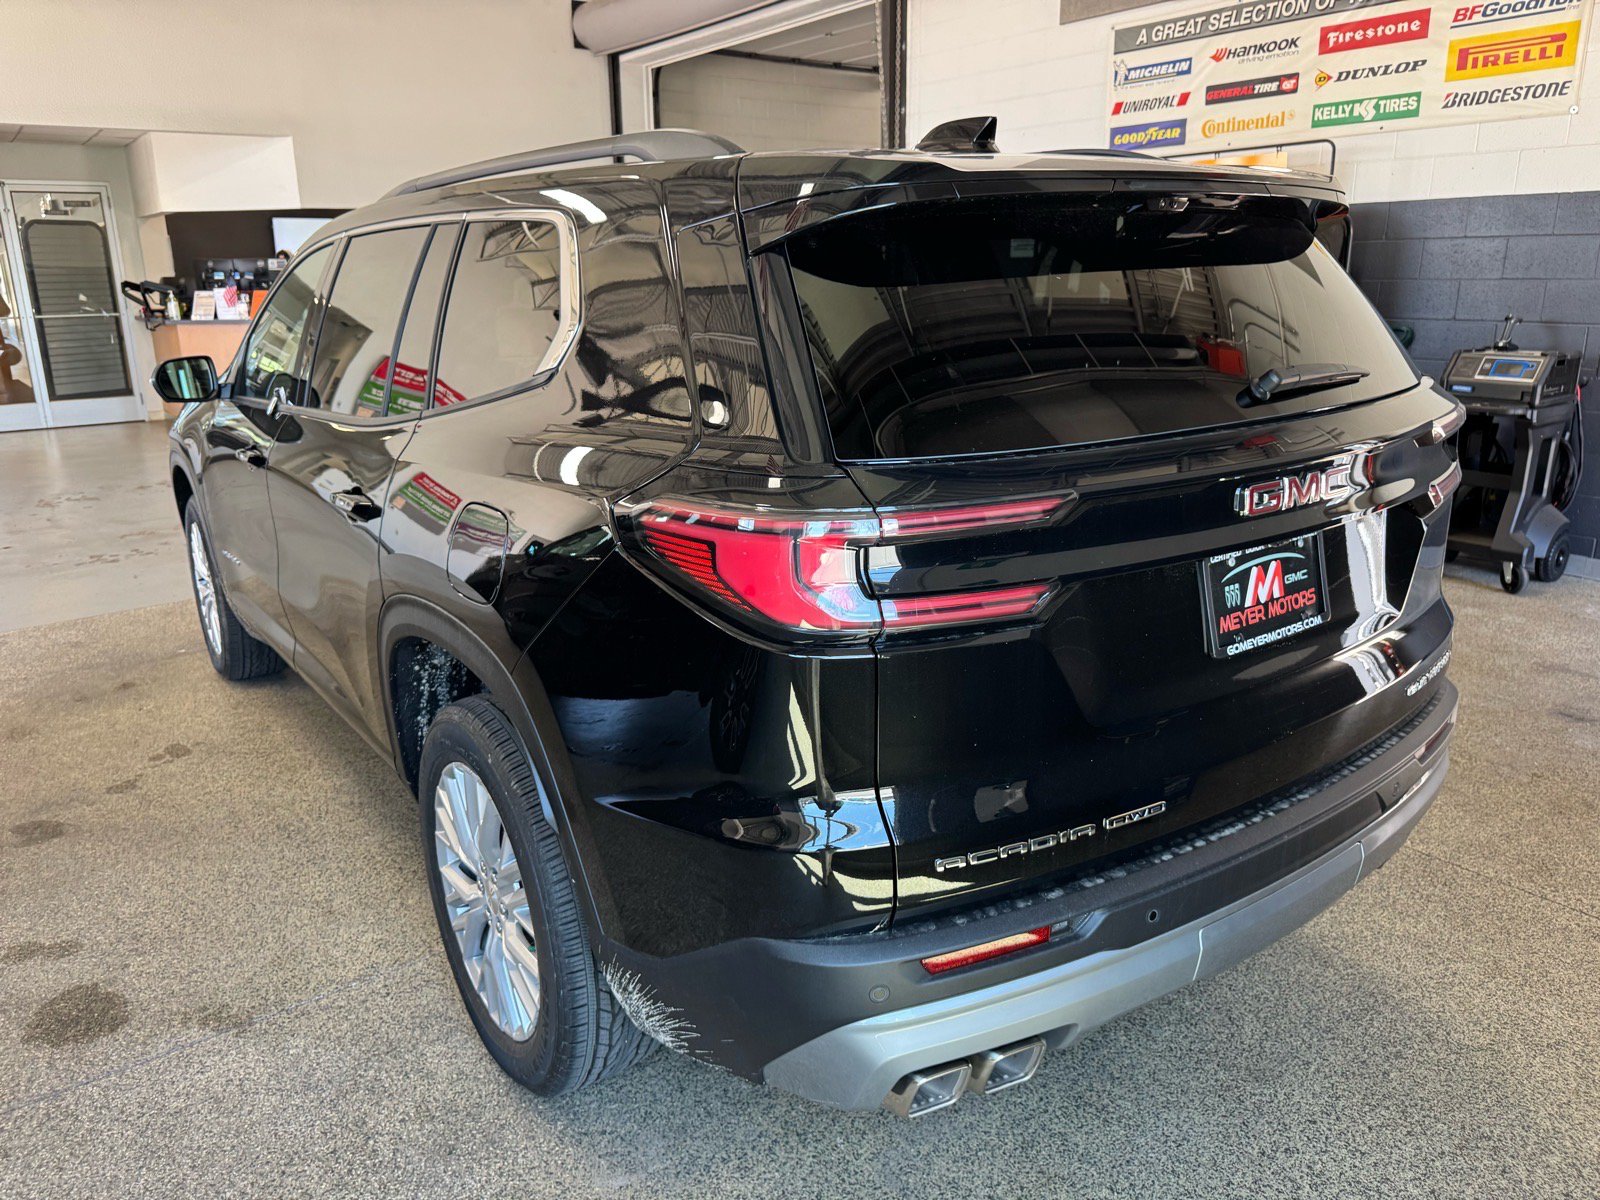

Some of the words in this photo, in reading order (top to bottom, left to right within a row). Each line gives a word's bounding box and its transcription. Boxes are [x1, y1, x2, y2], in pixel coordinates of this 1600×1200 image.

[1136, 28, 1148, 46] A
[1151, 16, 1207, 43] GREAT
[1208, 0, 1309, 31] SELECTION
[1452, 0, 1582, 23] BFGoodric
[1327, 18, 1421, 48] Firestone
[1238, 54, 1264, 65] driving
[1265, 50, 1300, 62] emotion
[1456, 33, 1567, 71] PIRELLI
[1128, 60, 1191, 80] MICHELIN
[1334, 59, 1427, 82] DUNLOP
[1123, 95, 1176, 114] UNIROYAL
[1441, 80, 1573, 109] BRIDGESTONE
[1314, 103, 1353, 121] KELLY
[1379, 96, 1418, 114] TIRES
[1113, 127, 1181, 145] GOODYEAR
[1201, 111, 1286, 138] Continental
[1240, 467, 1351, 517] GMC
[1284, 569, 1309, 585] GMC
[1220, 605, 1266, 634] MEYER
[1268, 587, 1316, 619] MOTORS
[1226, 615, 1323, 656] GOMEYERMOTORS.COM
[934, 823, 1097, 873] ACADIA
